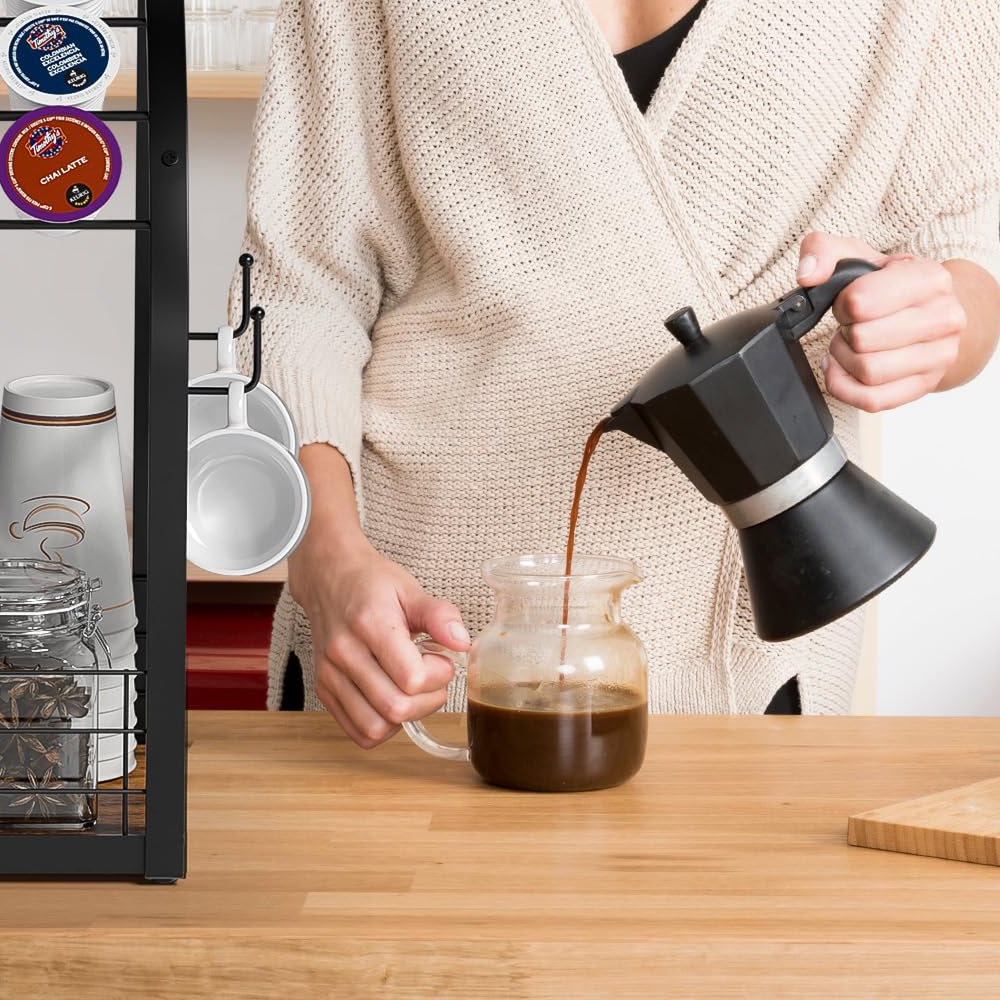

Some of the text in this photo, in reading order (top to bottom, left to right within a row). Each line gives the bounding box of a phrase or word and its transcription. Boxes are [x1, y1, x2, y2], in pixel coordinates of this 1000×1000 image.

[40, 43, 76, 61] COLOMBIAN
[39, 156, 88, 185] CHAI LATTE
